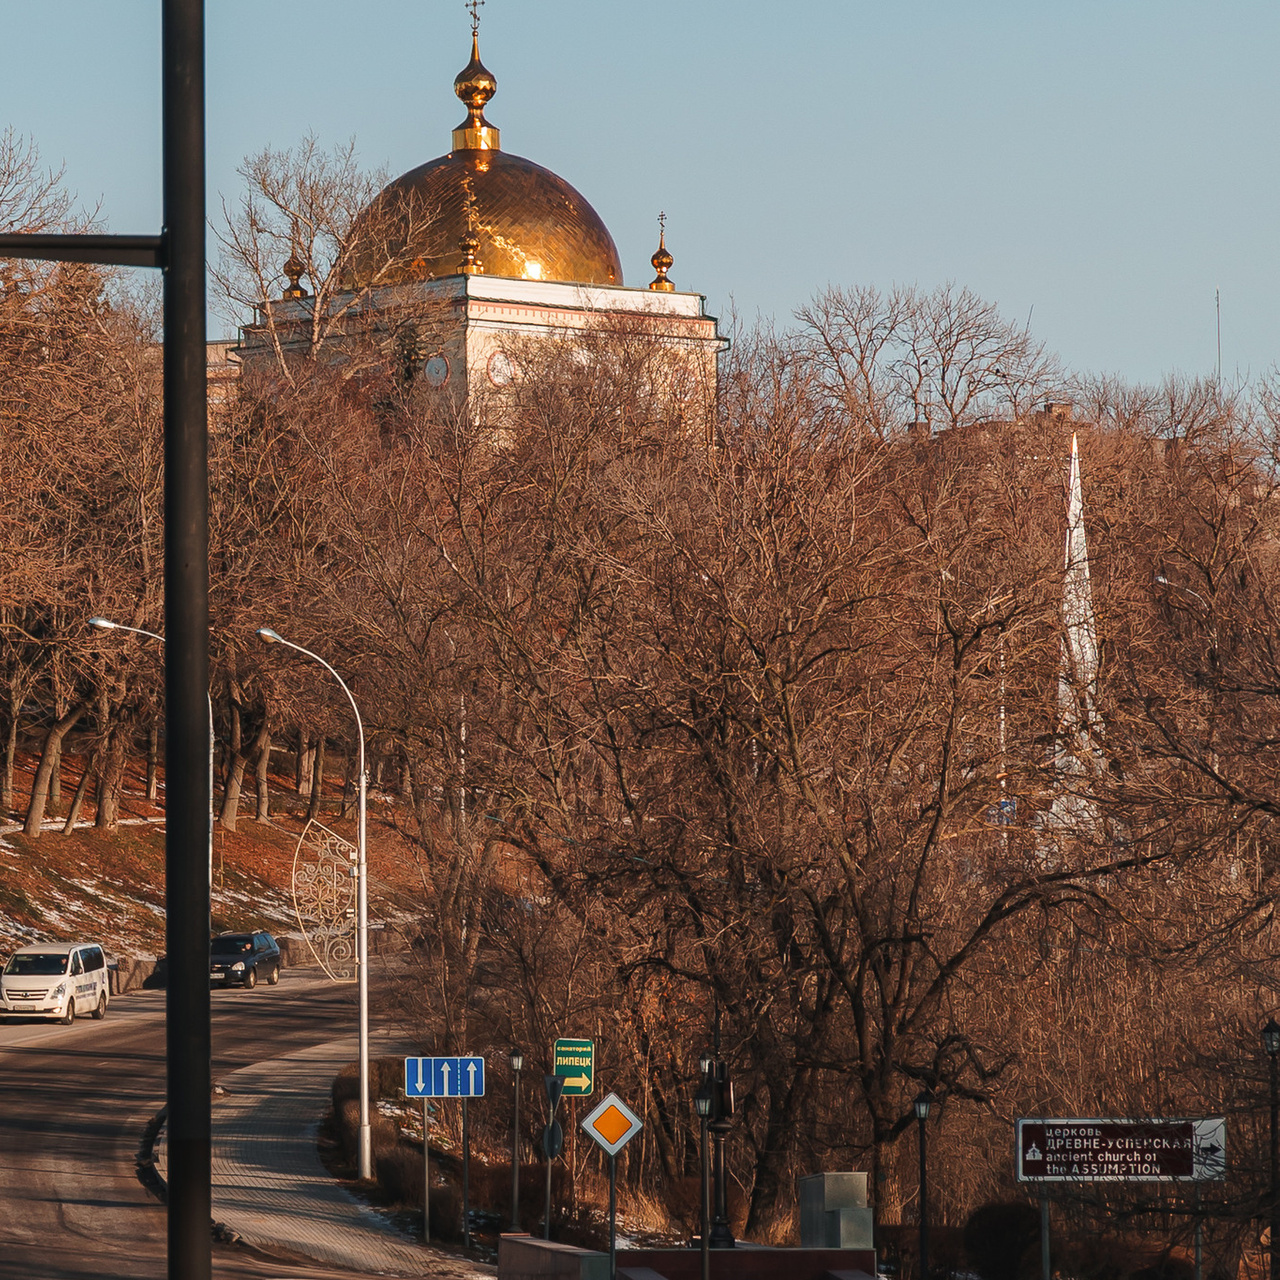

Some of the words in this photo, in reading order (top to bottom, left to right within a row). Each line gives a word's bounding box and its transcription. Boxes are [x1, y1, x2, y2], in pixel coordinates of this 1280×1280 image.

[556, 1056, 592, 1067] ЛИПЕЦК
[1046, 1128, 1102, 1138] церковь
[1046, 1151, 1094, 1162] ancient
[1098, 1151, 1141, 1162] church
[1072, 1164, 1161, 1174] ASSUMPTION
